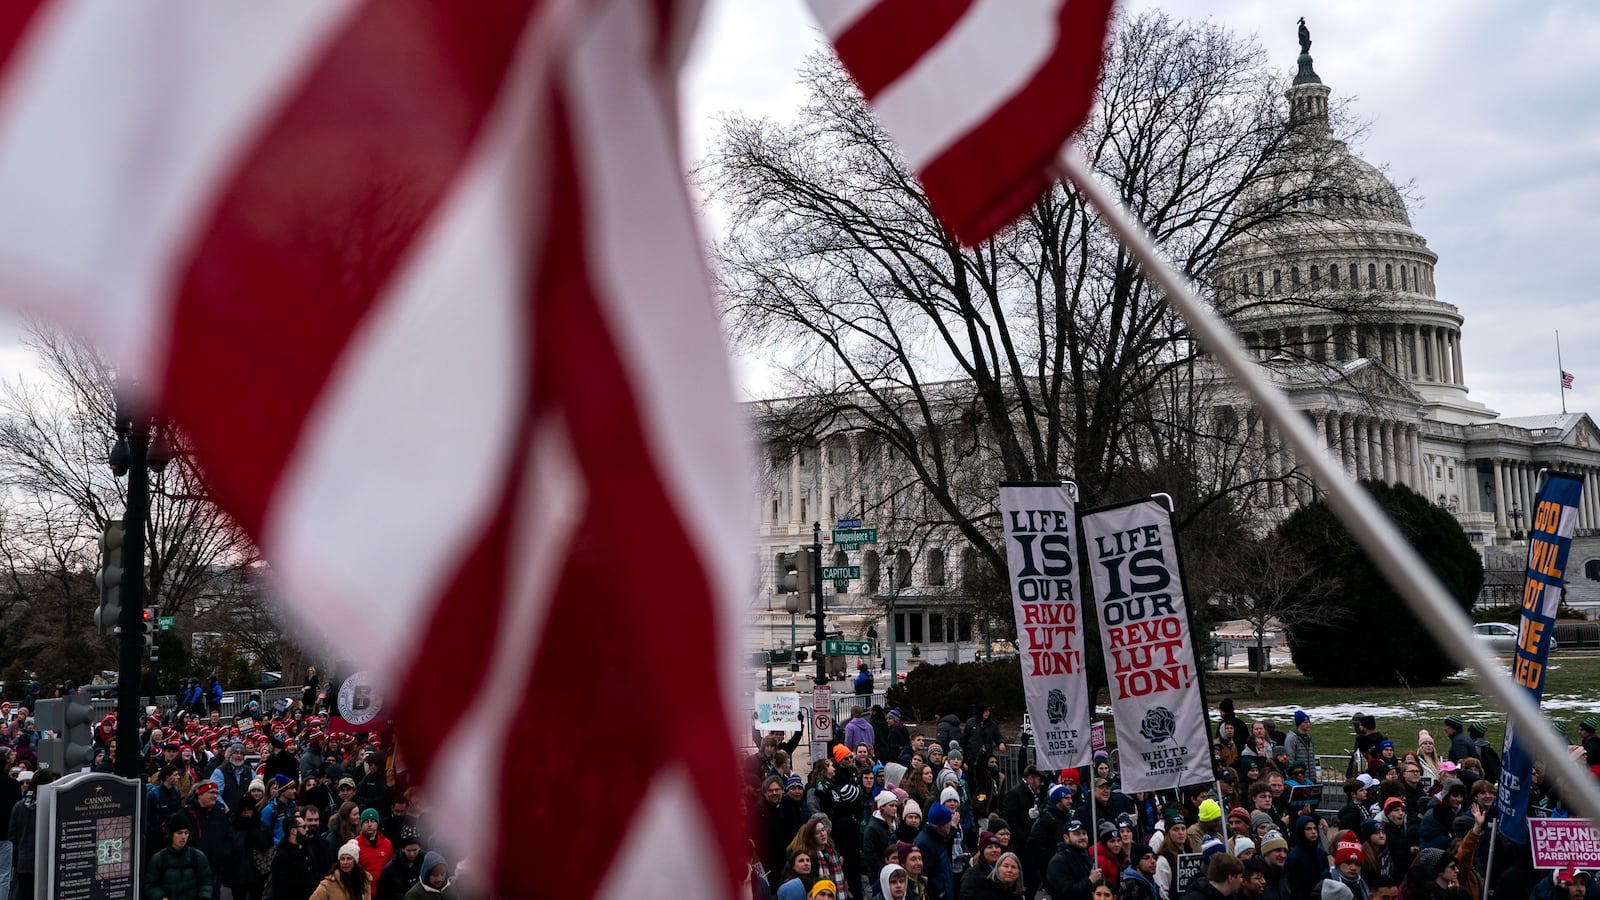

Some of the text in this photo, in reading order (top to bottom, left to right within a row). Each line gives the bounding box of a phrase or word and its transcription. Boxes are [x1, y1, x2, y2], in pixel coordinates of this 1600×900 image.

[1009, 510, 1068, 533] LIFE
[1534, 501, 1561, 535] GOD
[835, 531, 868, 542] Independence
[841, 543, 858, 551] UNIT
[1094, 524, 1162, 559] LIFE
[1012, 534, 1073, 578] IS
[1529, 538, 1563, 579] WILL
[823, 567, 853, 579] CAPITOL
[835, 579, 849, 587] 100
[1099, 549, 1171, 603] IS
[1018, 578, 1074, 602] OUR
[1021, 603, 1076, 625] REVO
[1104, 593, 1177, 626] OUR
[1024, 626, 1077, 650] LUT
[1107, 617, 1182, 650] REVO
[1029, 651, 1081, 677] ION!
[1111, 640, 1184, 674] LUT
[1114, 664, 1191, 700] ION!
[1049, 740, 1075, 751] ROSE
[1141, 746, 1188, 762] WHITE
[1145, 766, 1189, 777] RESISTANCE
[1150, 757, 1183, 770] ROSE
[84, 796, 112, 805] CANNON
[1535, 827, 1600, 840] DEFUND
[1537, 840, 1600, 852] PLANNED
[1538, 852, 1600, 861] PARENTHOO
